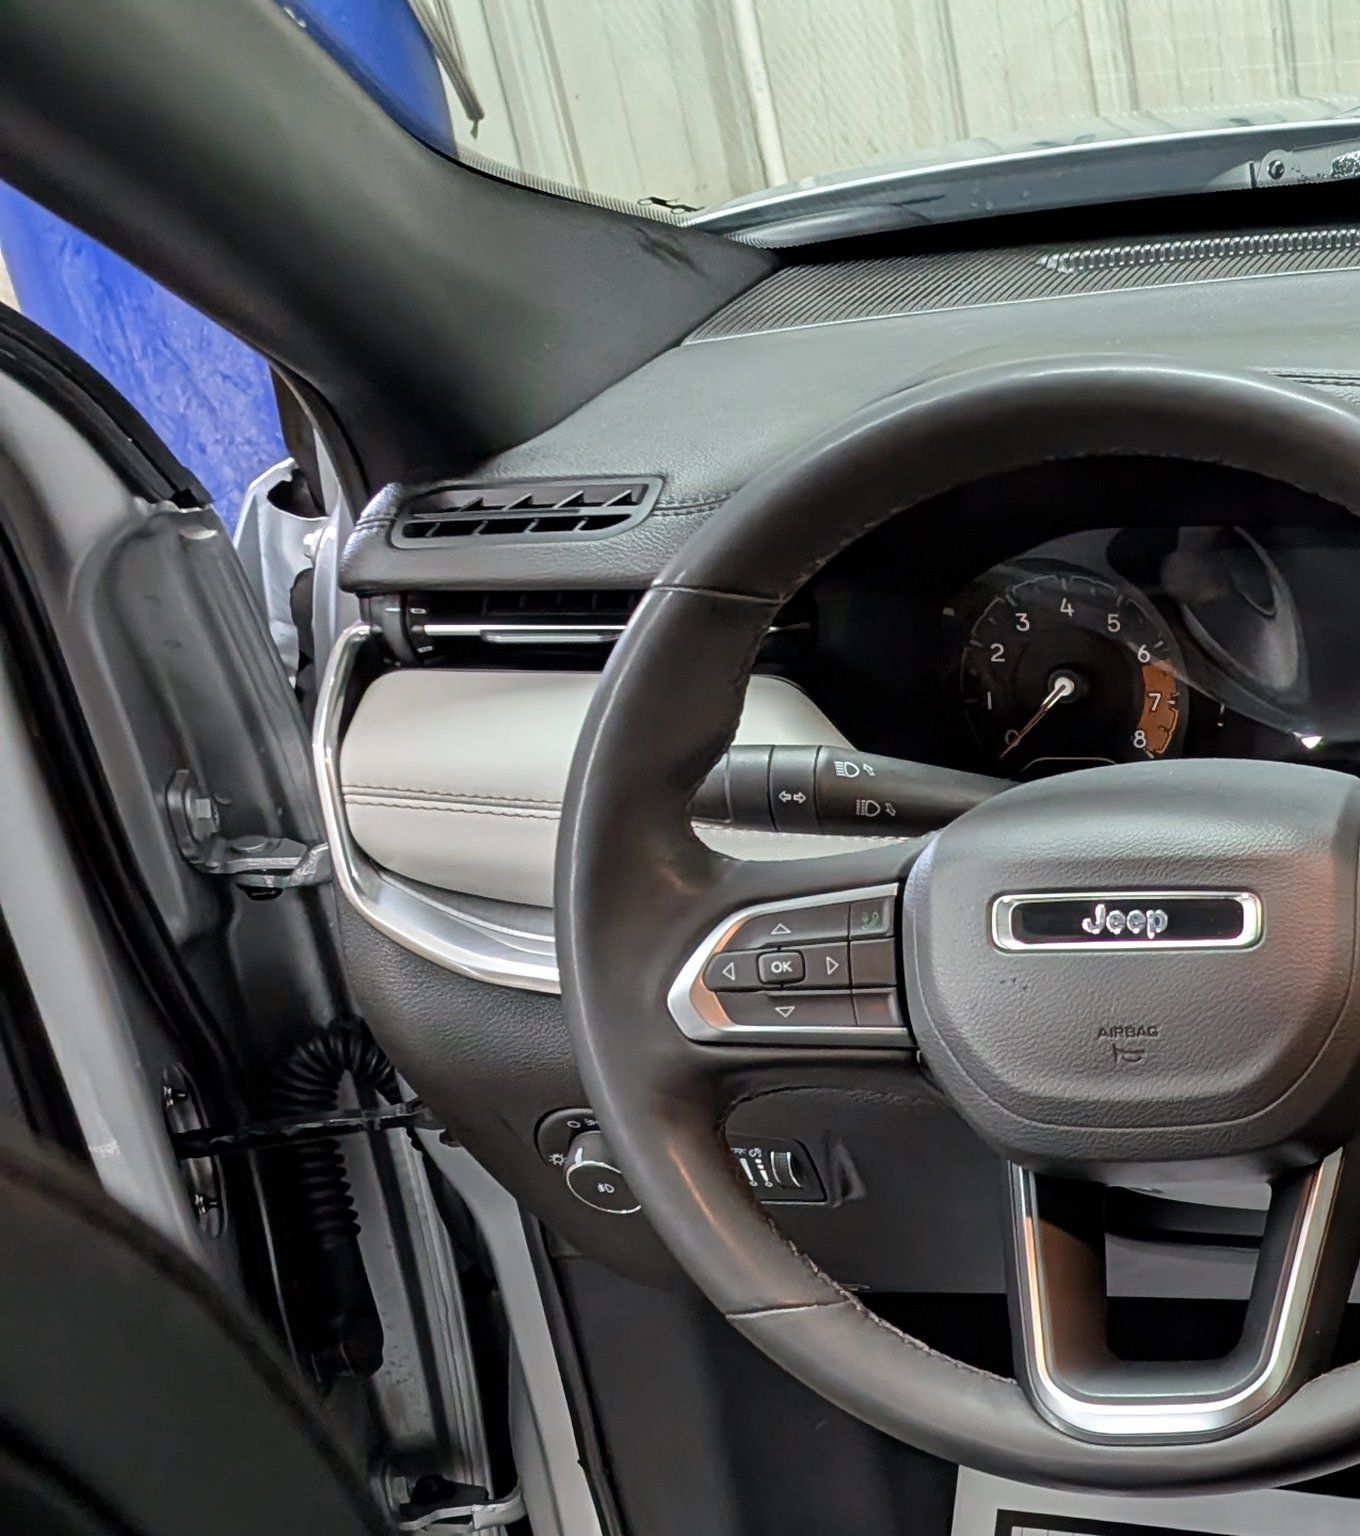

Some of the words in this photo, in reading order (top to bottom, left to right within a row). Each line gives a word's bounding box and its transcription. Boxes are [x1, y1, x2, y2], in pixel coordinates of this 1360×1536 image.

[1060, 597, 1075, 617] 4
[1014, 612, 1030, 632] 3
[1107, 613, 1121, 633] 5
[990, 643, 1006, 663] 2
[1137, 644, 1151, 664] 6
[1148, 693, 1162, 713] 7
[1132, 729, 1147, 749] 8
[1081, 903, 1169, 939] Jeep
[770, 960, 793, 974] OK
[1097, 1024, 1160, 1038] AIRBAG
